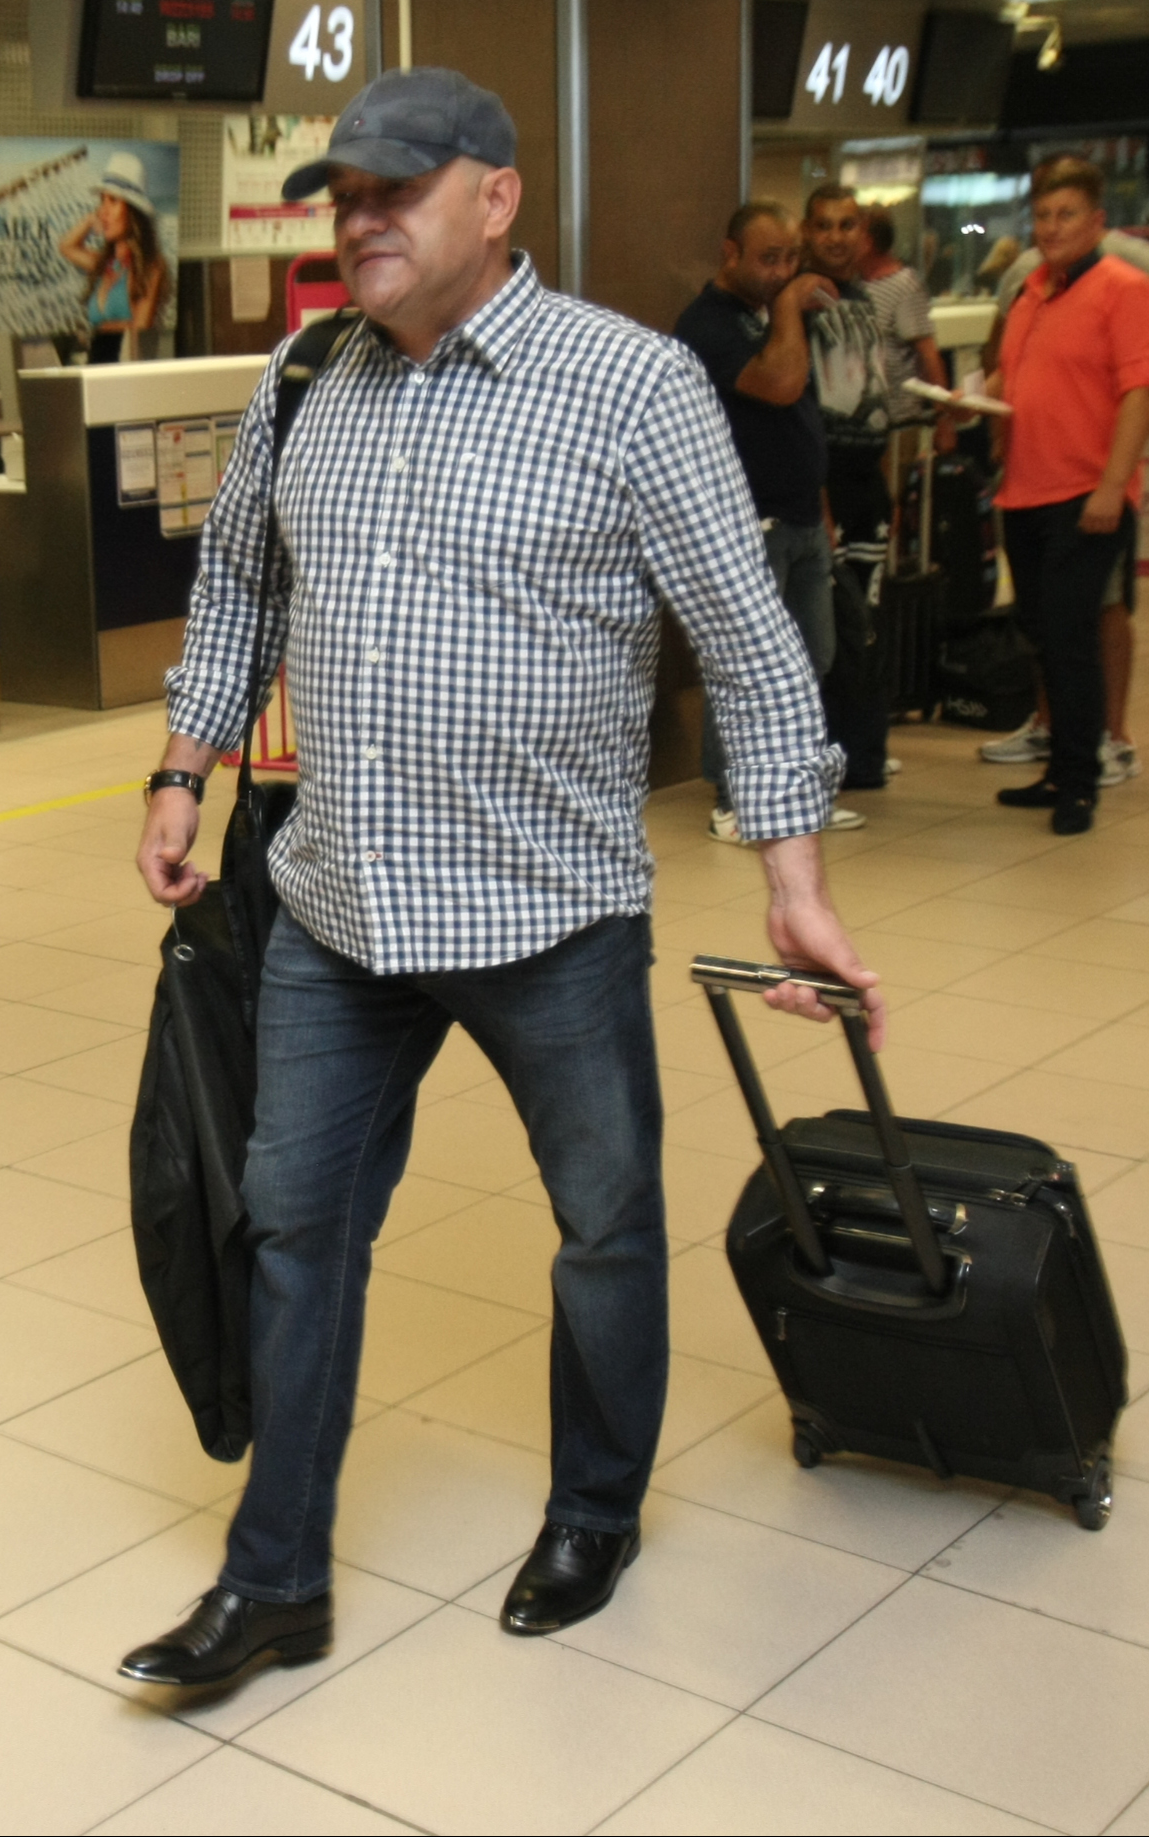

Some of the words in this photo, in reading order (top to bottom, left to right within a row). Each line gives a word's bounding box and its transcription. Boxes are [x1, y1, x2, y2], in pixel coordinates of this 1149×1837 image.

[288, 4, 354, 82] 43
[805, 43, 850, 104] 41
[863, 45, 908, 106] 40
